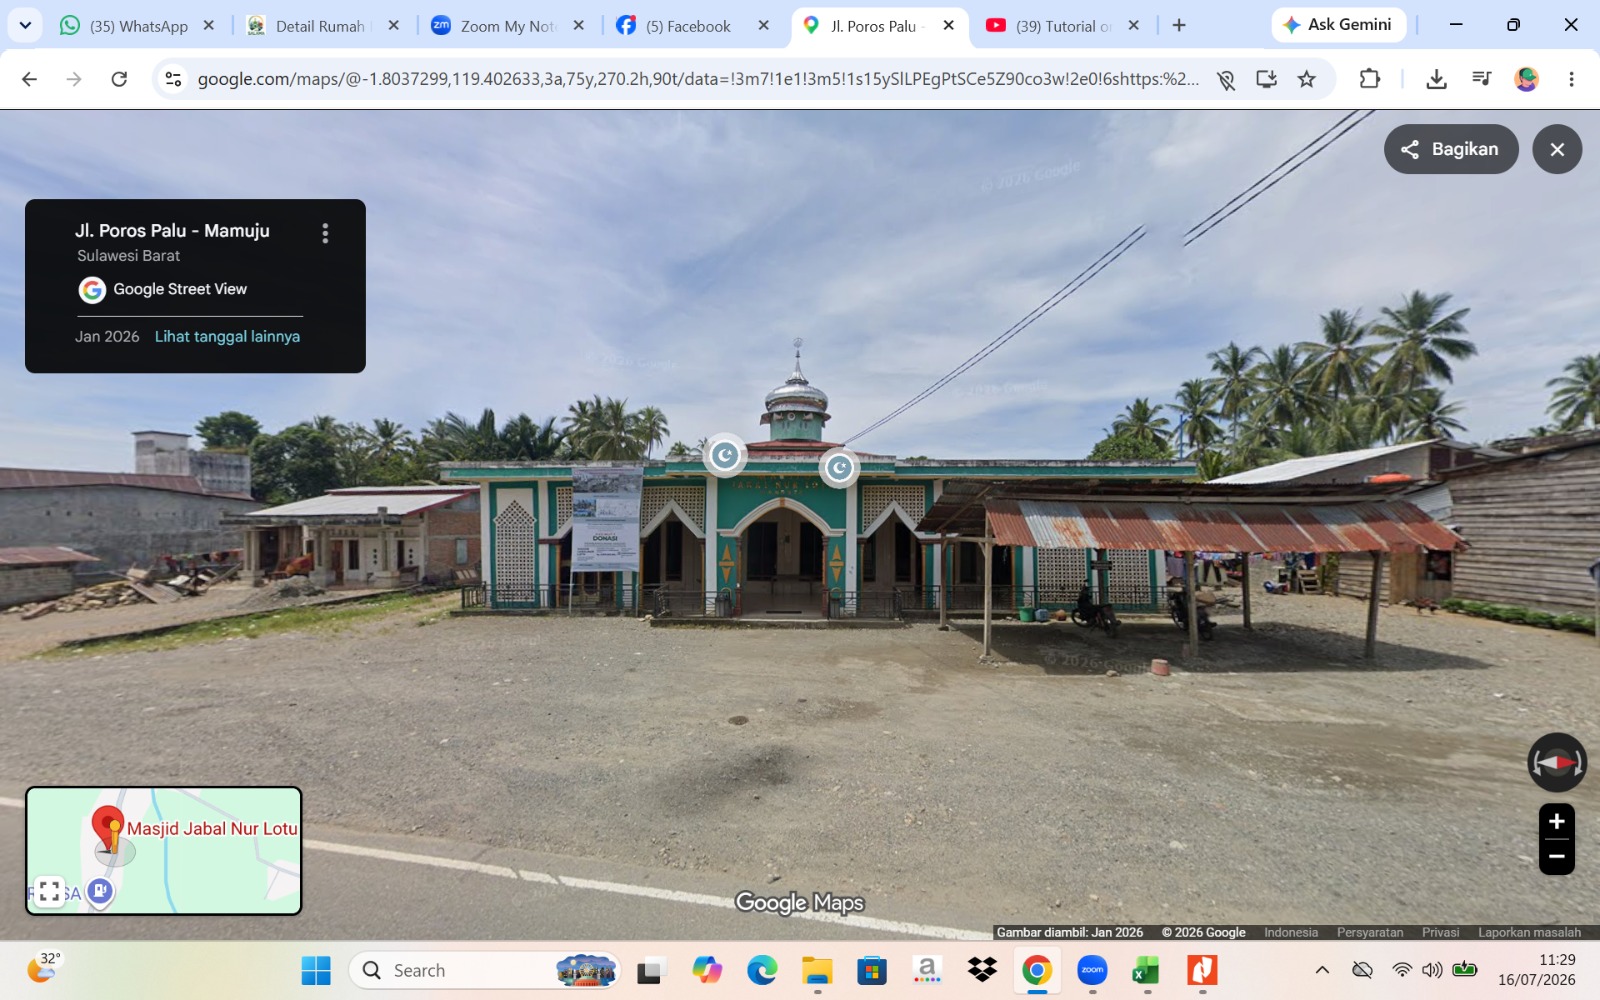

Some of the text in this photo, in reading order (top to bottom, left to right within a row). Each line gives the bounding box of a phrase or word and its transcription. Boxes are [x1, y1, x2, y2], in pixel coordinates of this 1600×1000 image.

[91, 20, 188, 36] (35) WhatsApp
[277, 19, 364, 33] Detail Rumah
[461, 20, 499, 33] Zoom
[505, 20, 525, 36] My
[647, 19, 731, 35] (5) Facebook
[831, 20, 843, 33] Jl.
[848, 20, 884, 33] Poros
[890, 19, 916, 33] Palu
[1017, 20, 1041, 35] (39)
[1046, 19, 1095, 33] Tutorial
[1308, 17, 1391, 31] Ask Gemini
[41, 952, 61, 965] 32°
[1541, 953, 1577, 966] 11:29
[394, 962, 446, 978] Search
[1498, 973, 1577, 988] 16/07/2026
